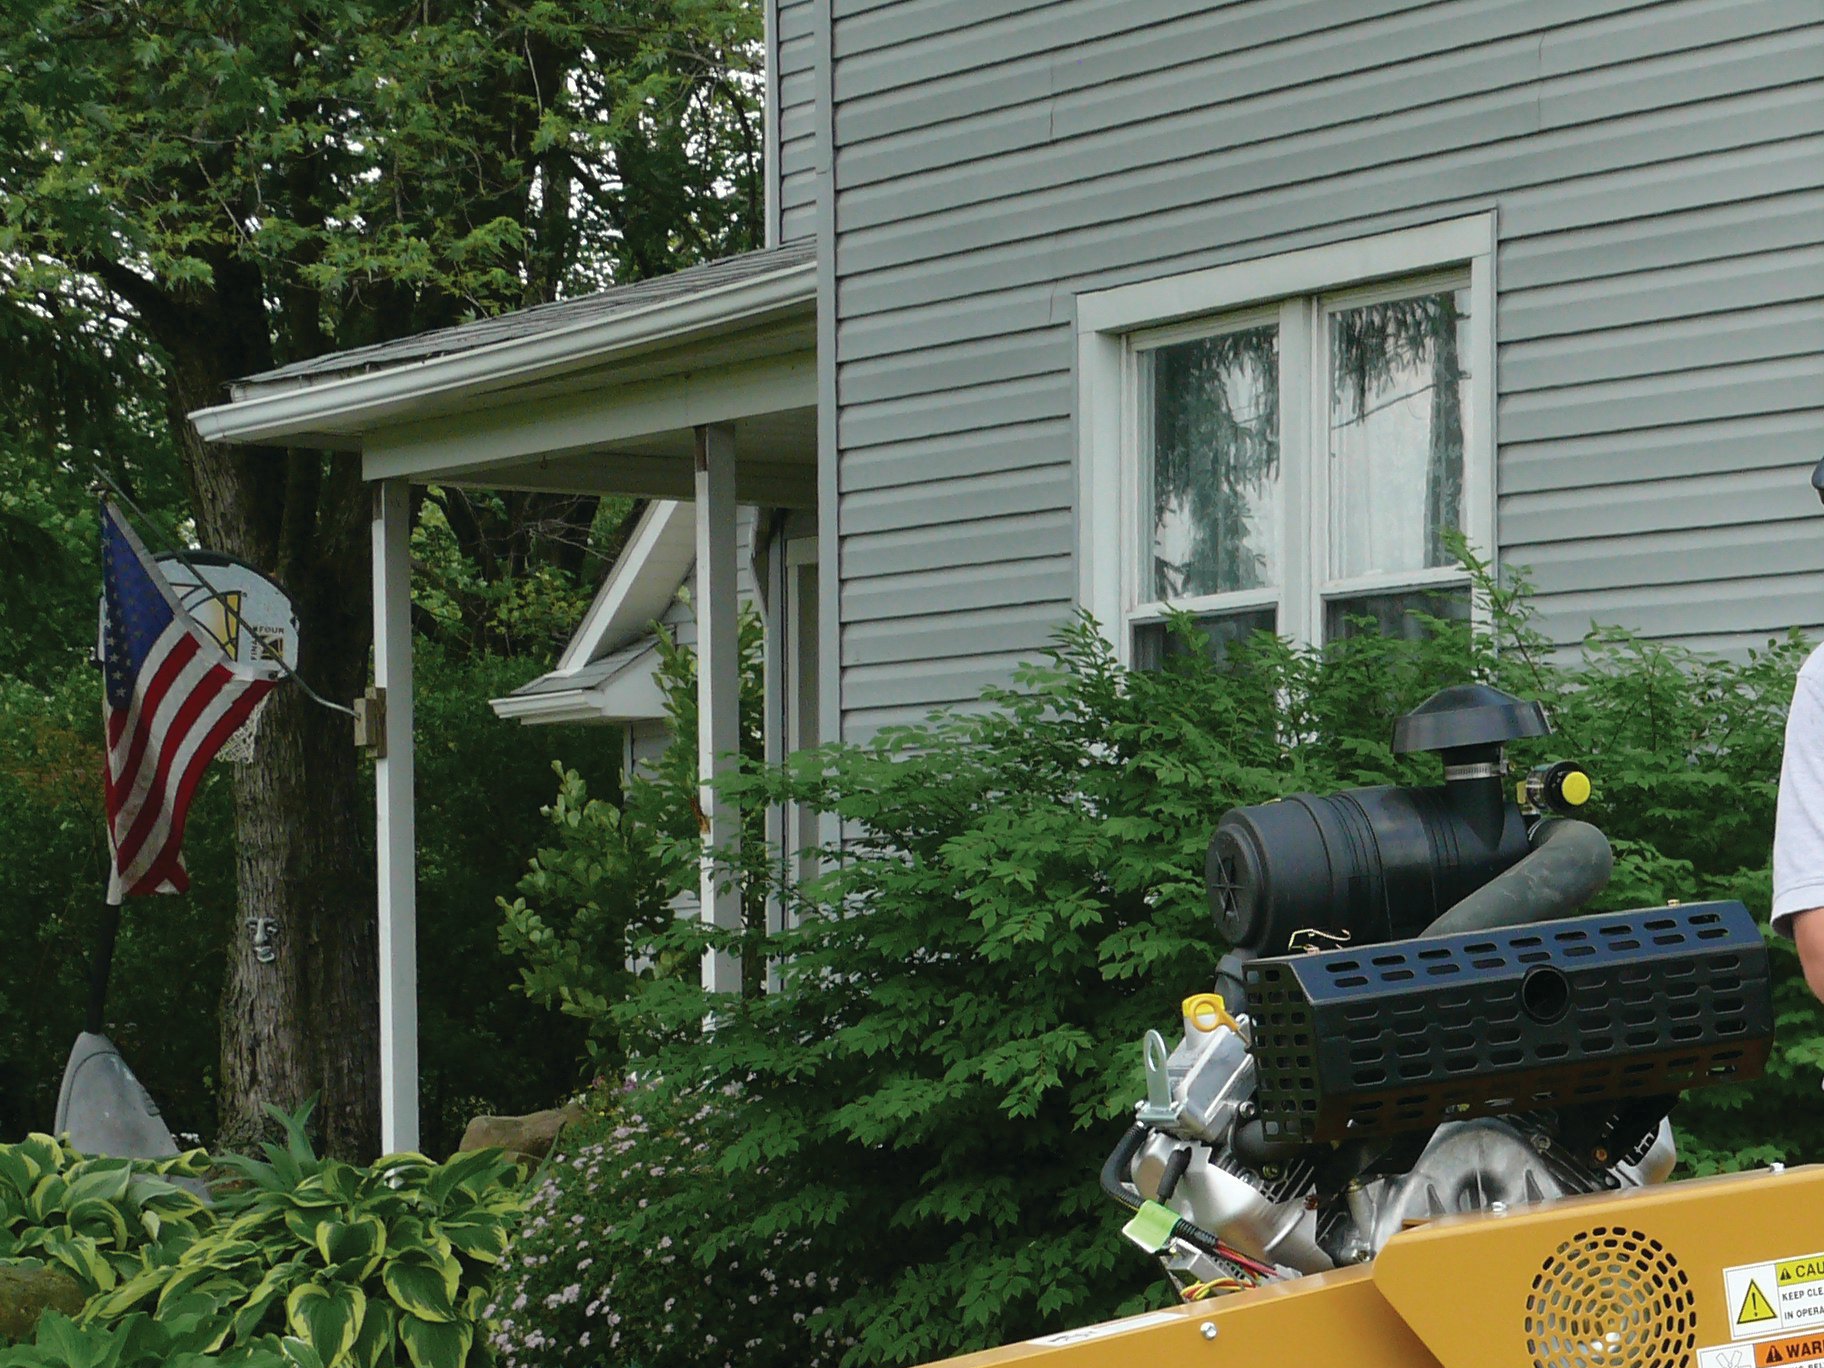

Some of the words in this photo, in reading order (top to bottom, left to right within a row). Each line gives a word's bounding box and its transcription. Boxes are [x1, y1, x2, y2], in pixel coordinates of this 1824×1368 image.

[259, 626, 285, 634] FOUR
[1782, 1290, 1804, 1301] KEEP
[1784, 1311, 1794, 1320] IN
